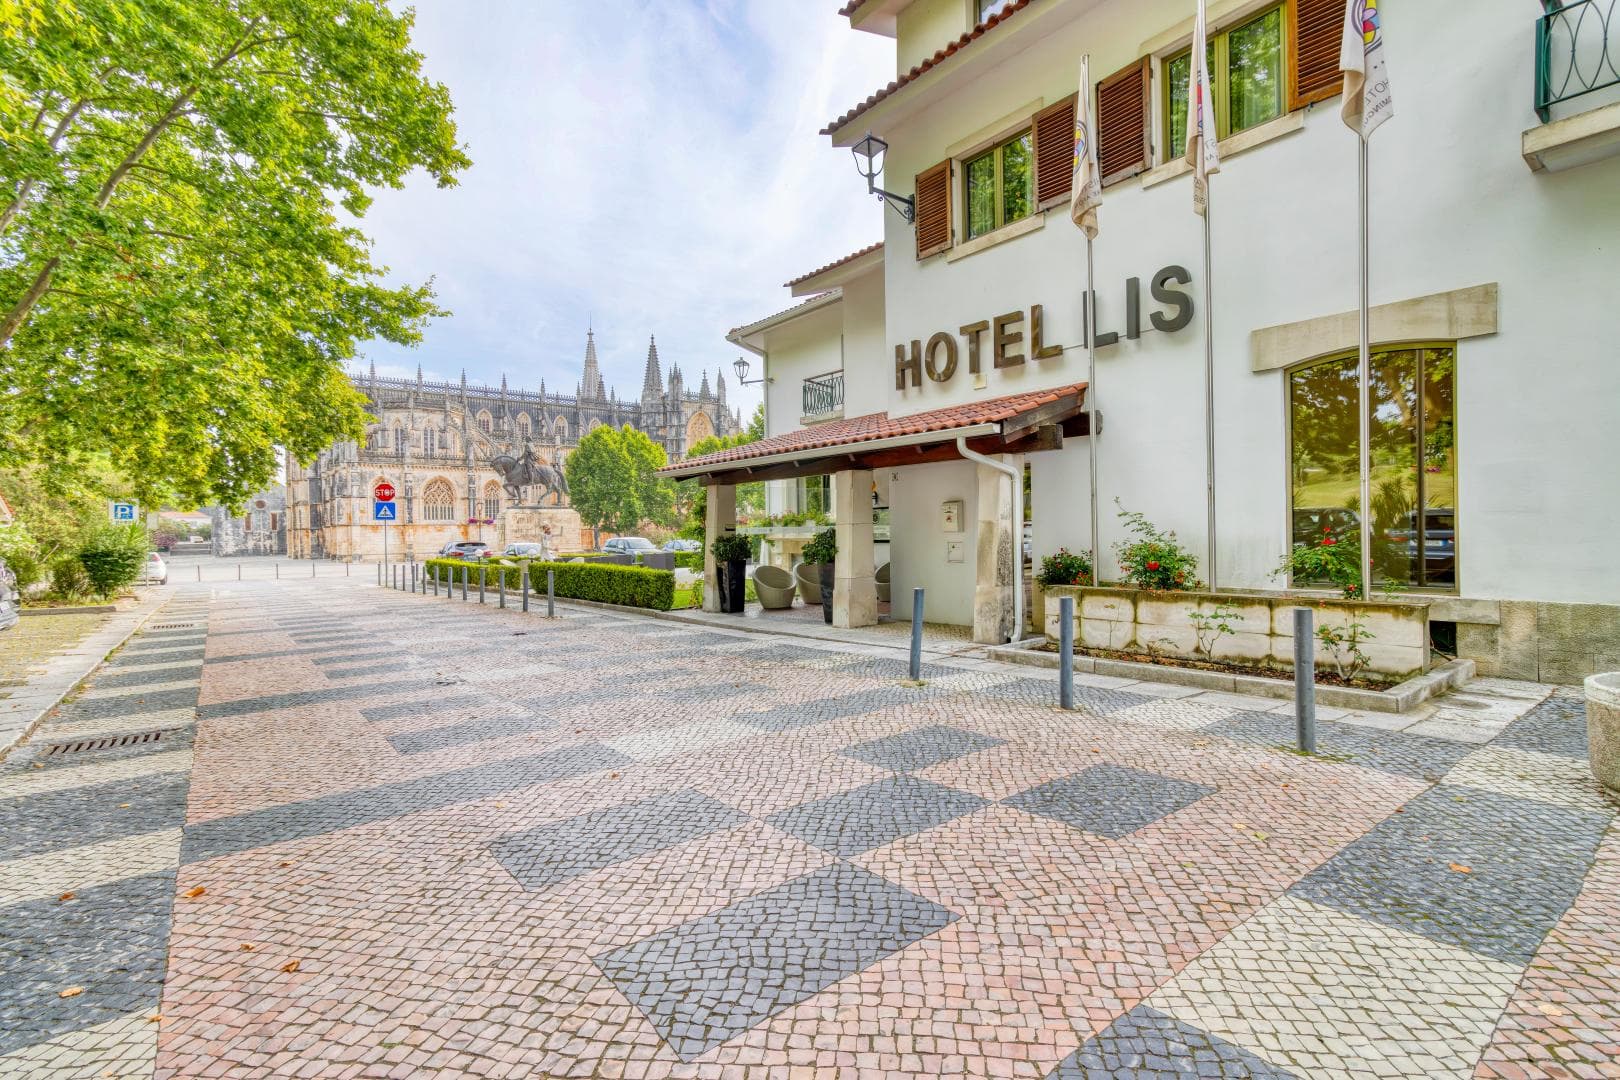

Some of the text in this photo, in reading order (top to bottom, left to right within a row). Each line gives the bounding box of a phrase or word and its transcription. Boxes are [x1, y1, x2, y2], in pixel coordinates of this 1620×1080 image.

[895, 265, 1195, 391] HOTEL LIS
[375, 488, 395, 497] STOP
[117, 505, 130, 519] P
